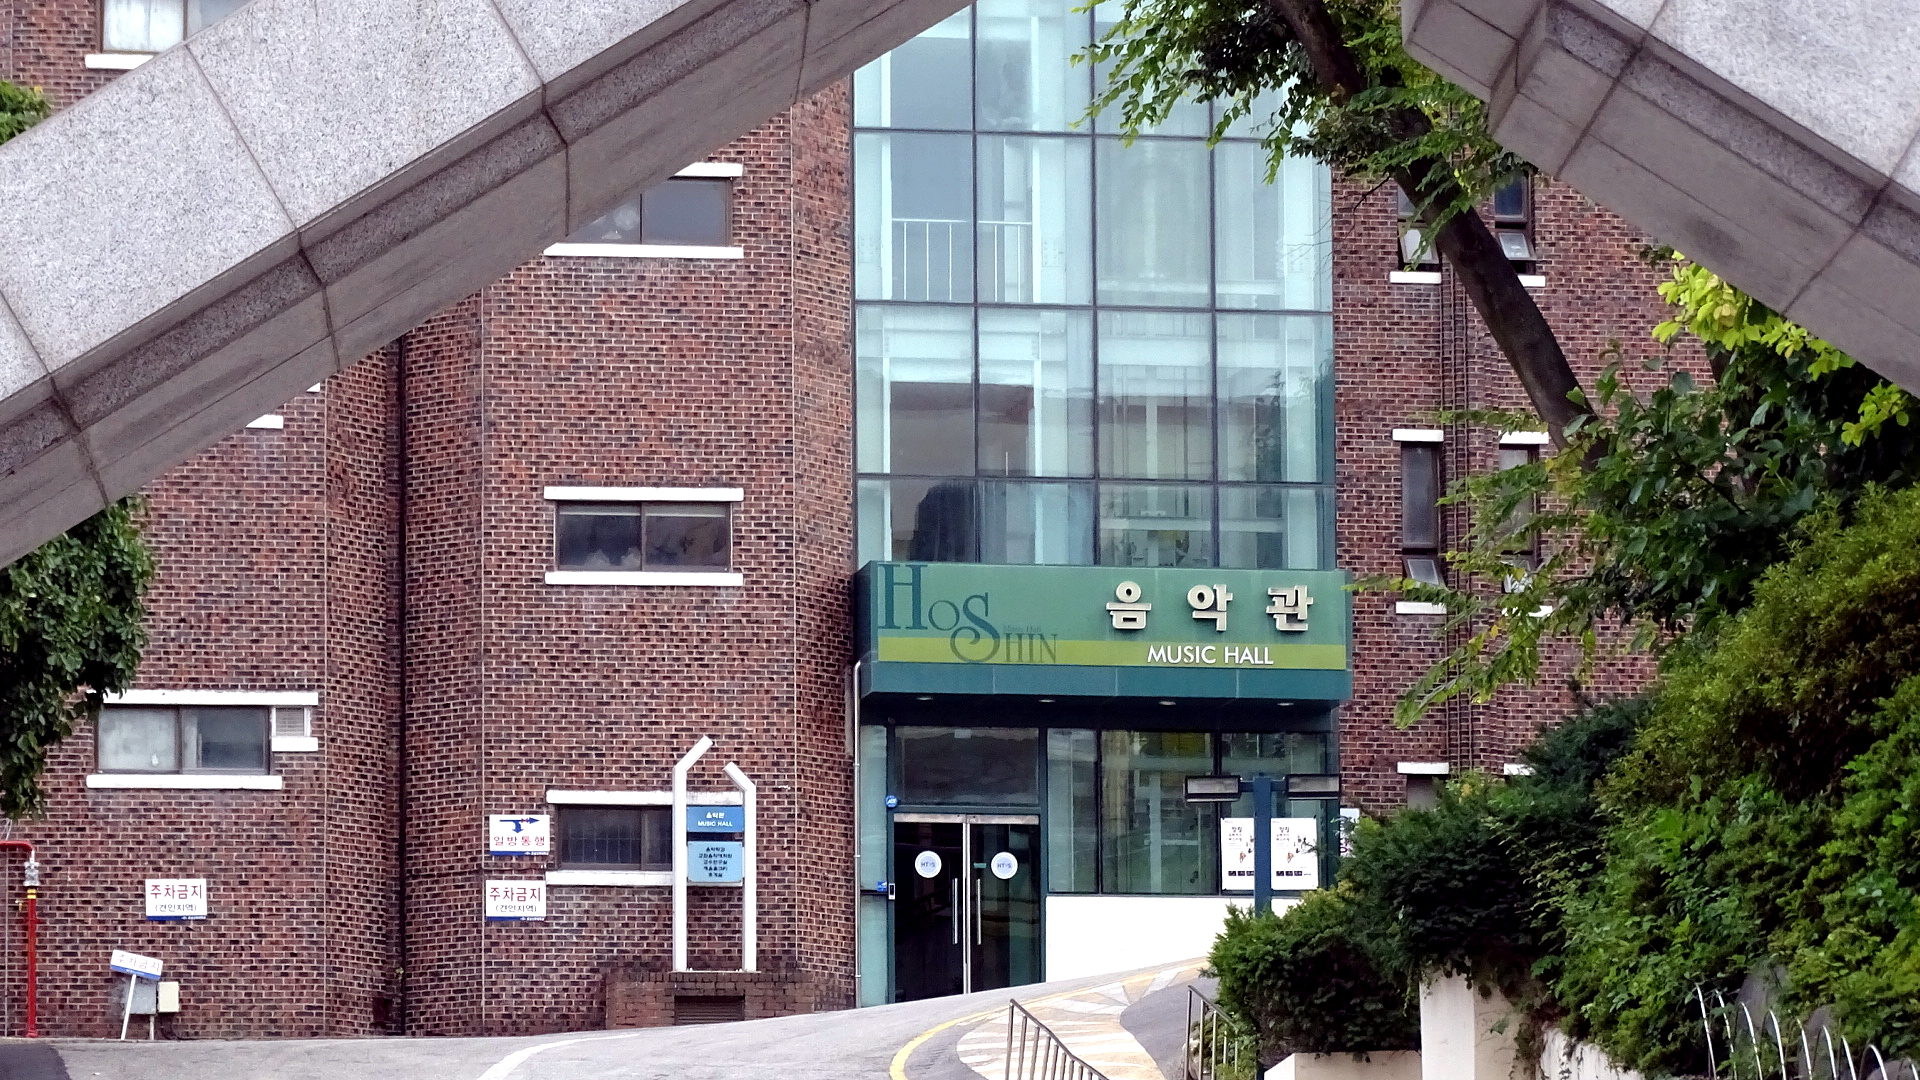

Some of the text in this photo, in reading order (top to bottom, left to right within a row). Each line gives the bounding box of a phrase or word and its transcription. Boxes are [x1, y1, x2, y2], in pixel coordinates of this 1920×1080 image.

[1106, 581, 1313, 631] 음악관
[1147, 645, 1274, 665] MUSIC HALL
[493, 836, 545, 847] 일방통행
[150, 884, 202, 900] 주차금지
[489, 887, 541, 902] 주차금지
[155, 904, 197, 912] (견인지역)
[495, 904, 537, 913] (견인지역)
[118, 954, 161, 973] 주차금지
